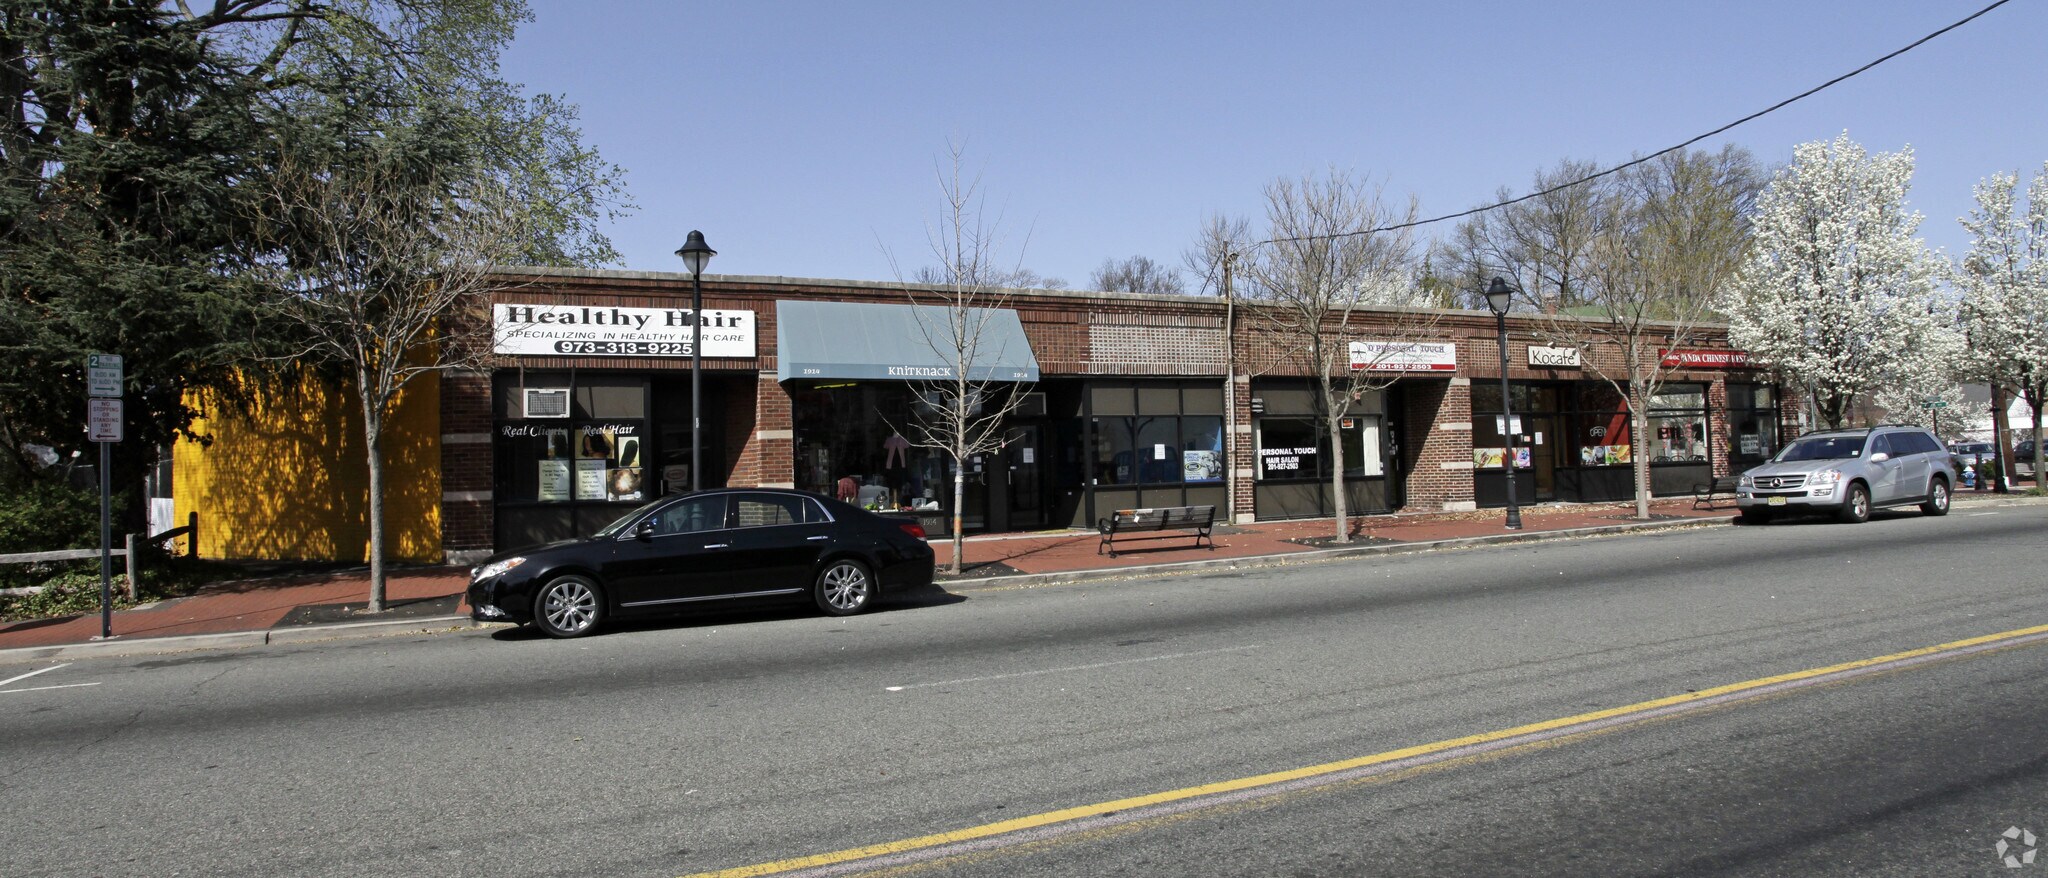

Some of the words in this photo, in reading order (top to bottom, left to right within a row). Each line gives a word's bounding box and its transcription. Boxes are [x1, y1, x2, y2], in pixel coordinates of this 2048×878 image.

[507, 306, 651, 330] Healthy
[663, 310, 742, 328] Hair
[507, 330, 596, 340] SPECIALIZING
[603, 332, 616, 340] IN
[620, 333, 676, 341] HEALTHY
[681, 333, 709, 342] HR
[713, 334, 745, 342] CARE
[560, 341, 693, 355] 973-313-9225
[1420, 345, 1445, 353] TOUCH
[91, 356, 98, 366] 2
[502, 424, 529, 437] Real
[582, 423, 608, 437] Real
[608, 423, 635, 435] Hair
[1258, 448, 1293, 456] PERSONAL
